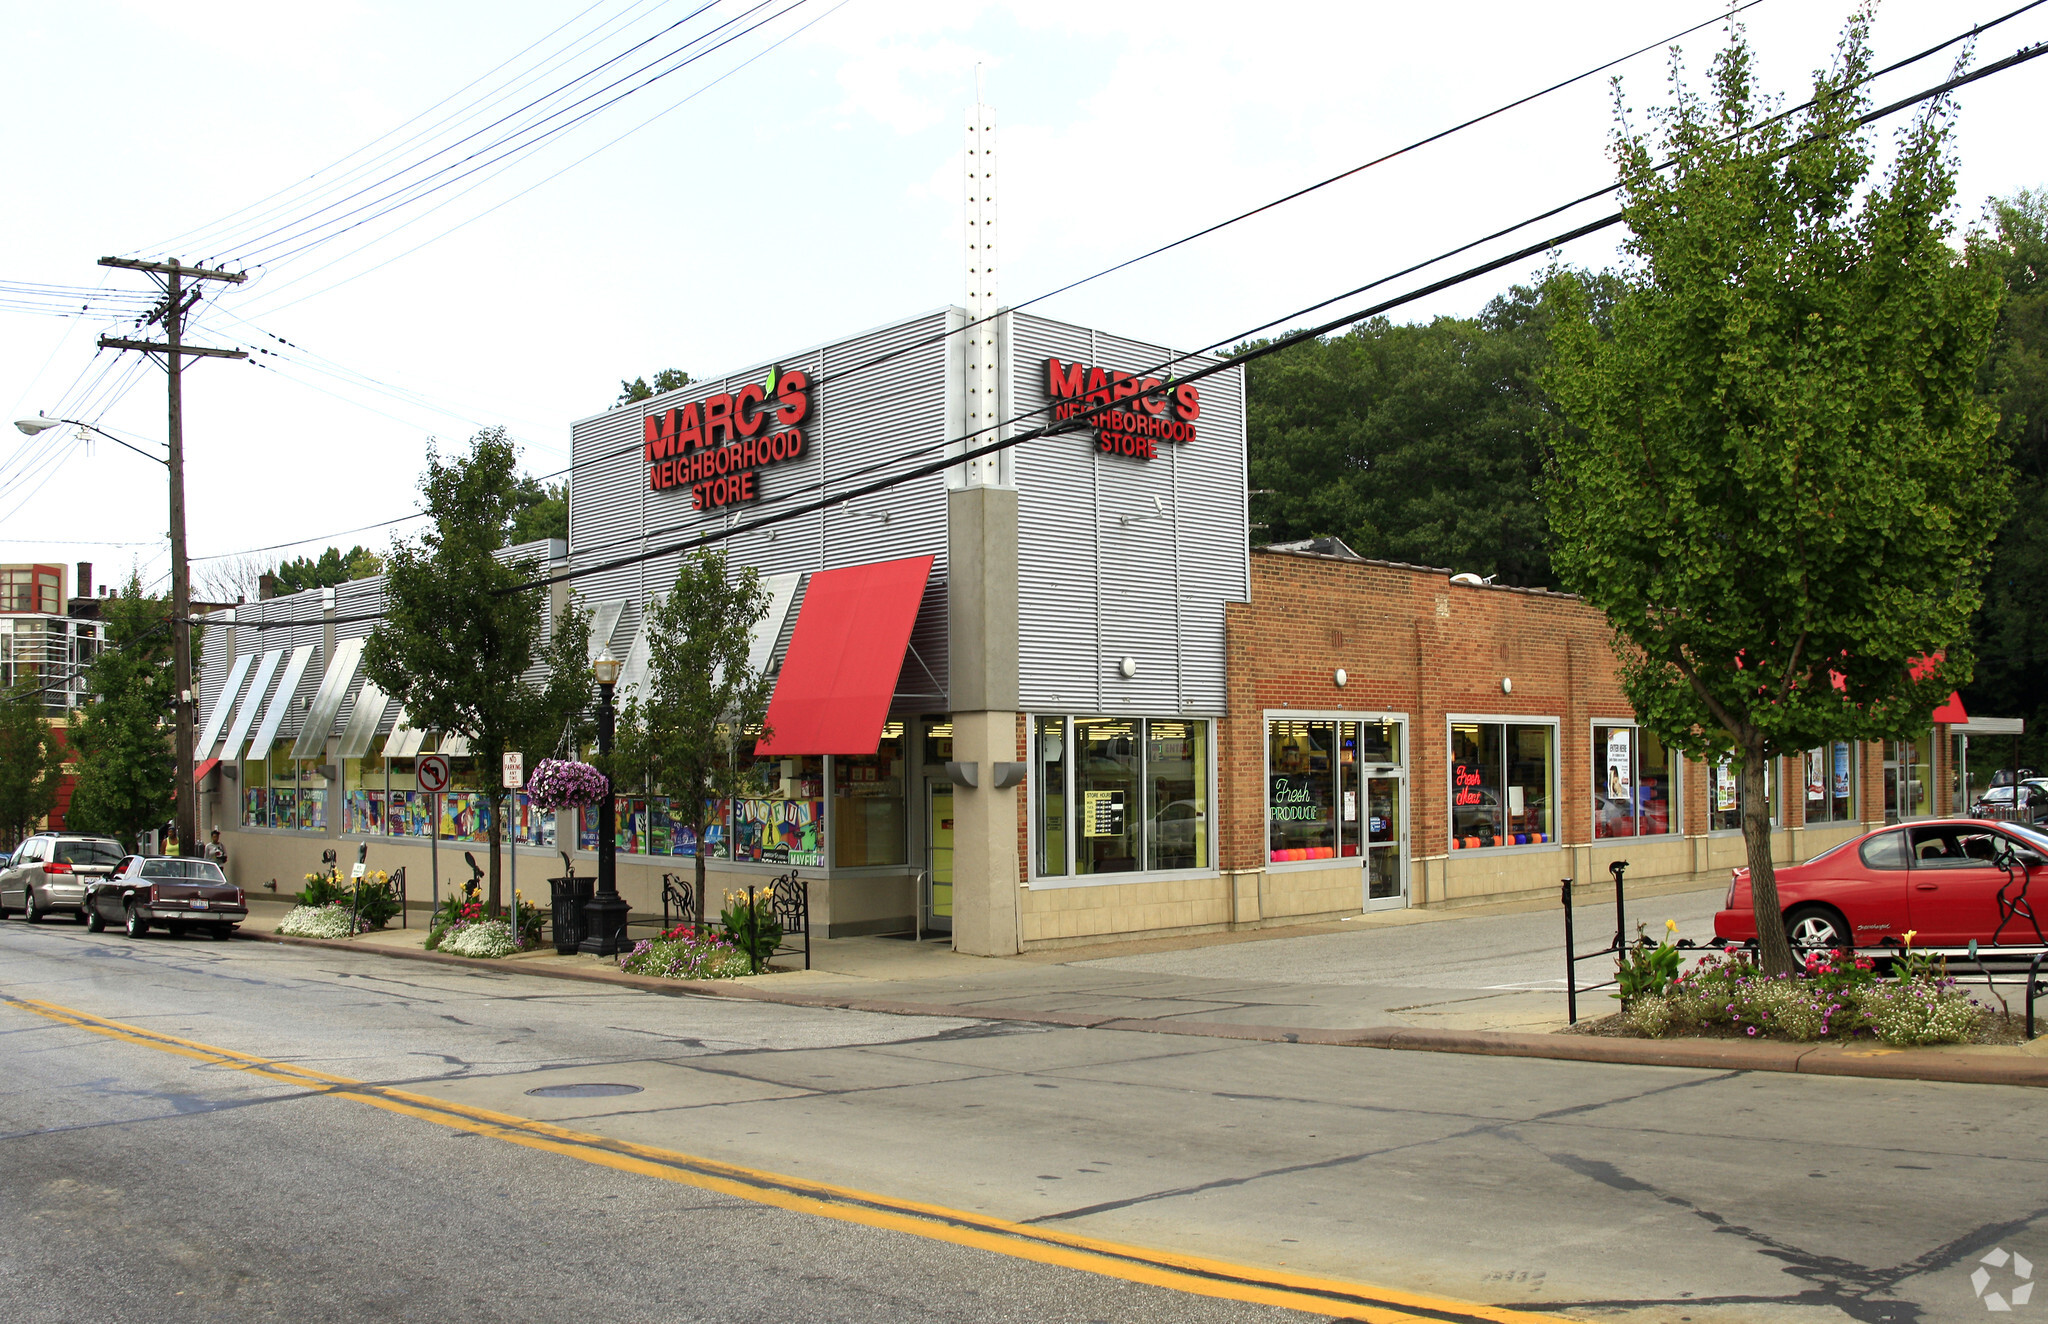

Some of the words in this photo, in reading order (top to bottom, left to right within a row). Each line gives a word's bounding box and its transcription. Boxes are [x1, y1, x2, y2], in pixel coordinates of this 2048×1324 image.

[1049, 357, 1201, 421] MARC'S
[644, 365, 808, 462] MARC'S
[1055, 400, 1197, 443] NEIGHBORHOOD
[650, 428, 802, 491] NEIGHBORHOOD
[1100, 431, 1158, 459] STORE
[691, 472, 754, 511] STORE
[1275, 778, 1310, 803] Fresh
[1456, 765, 1481, 786] Fresh
[1455, 785, 1481, 806] Meat
[1270, 805, 1317, 821] PRODUCE
